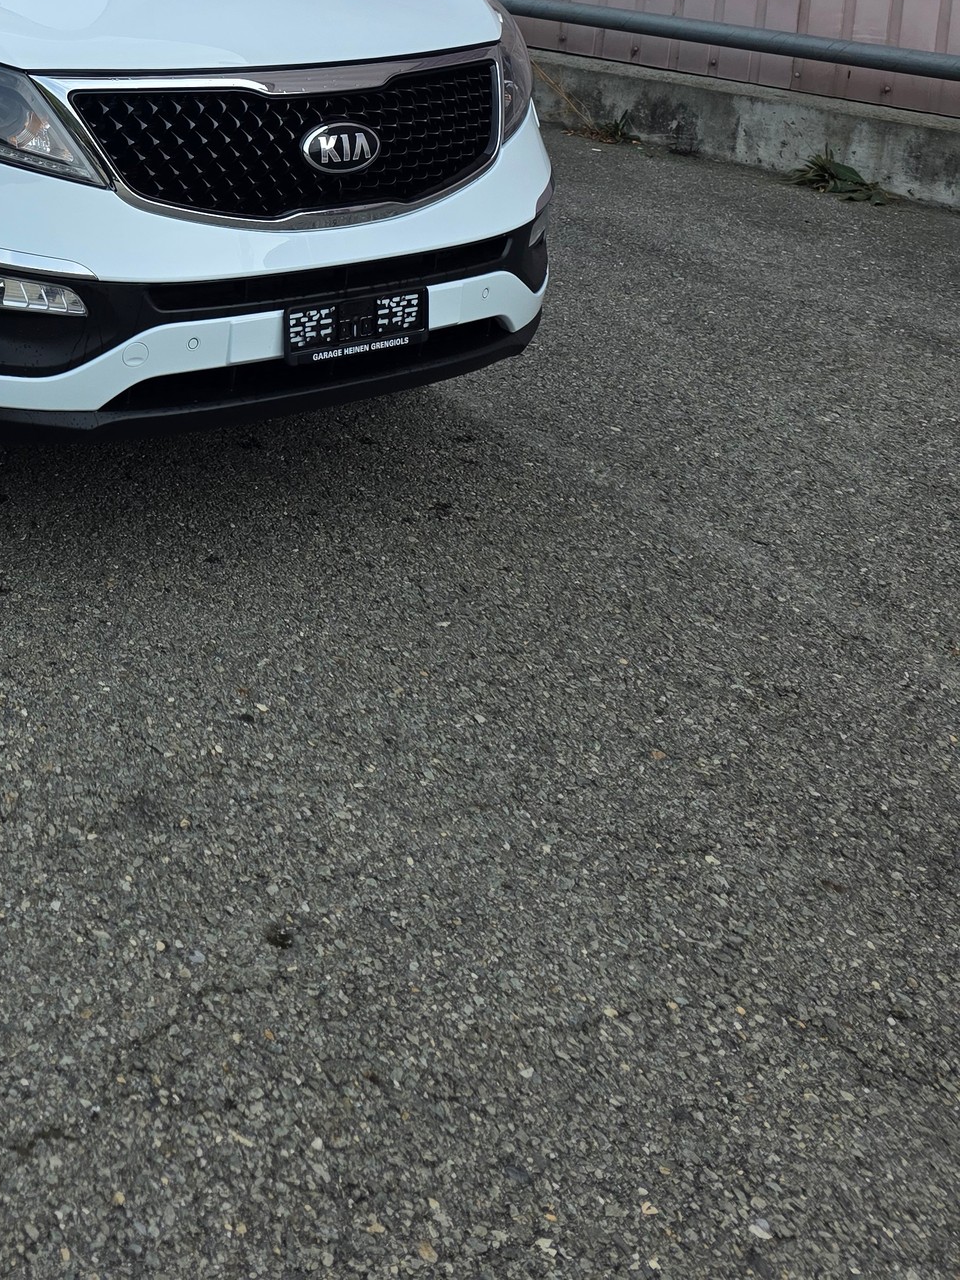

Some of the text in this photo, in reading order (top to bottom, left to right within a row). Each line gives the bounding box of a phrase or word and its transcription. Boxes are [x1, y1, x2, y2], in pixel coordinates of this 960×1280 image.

[318, 132, 372, 164] KIA
[312, 336, 409, 361] GARAGE HEINEN GRENGIOLS
